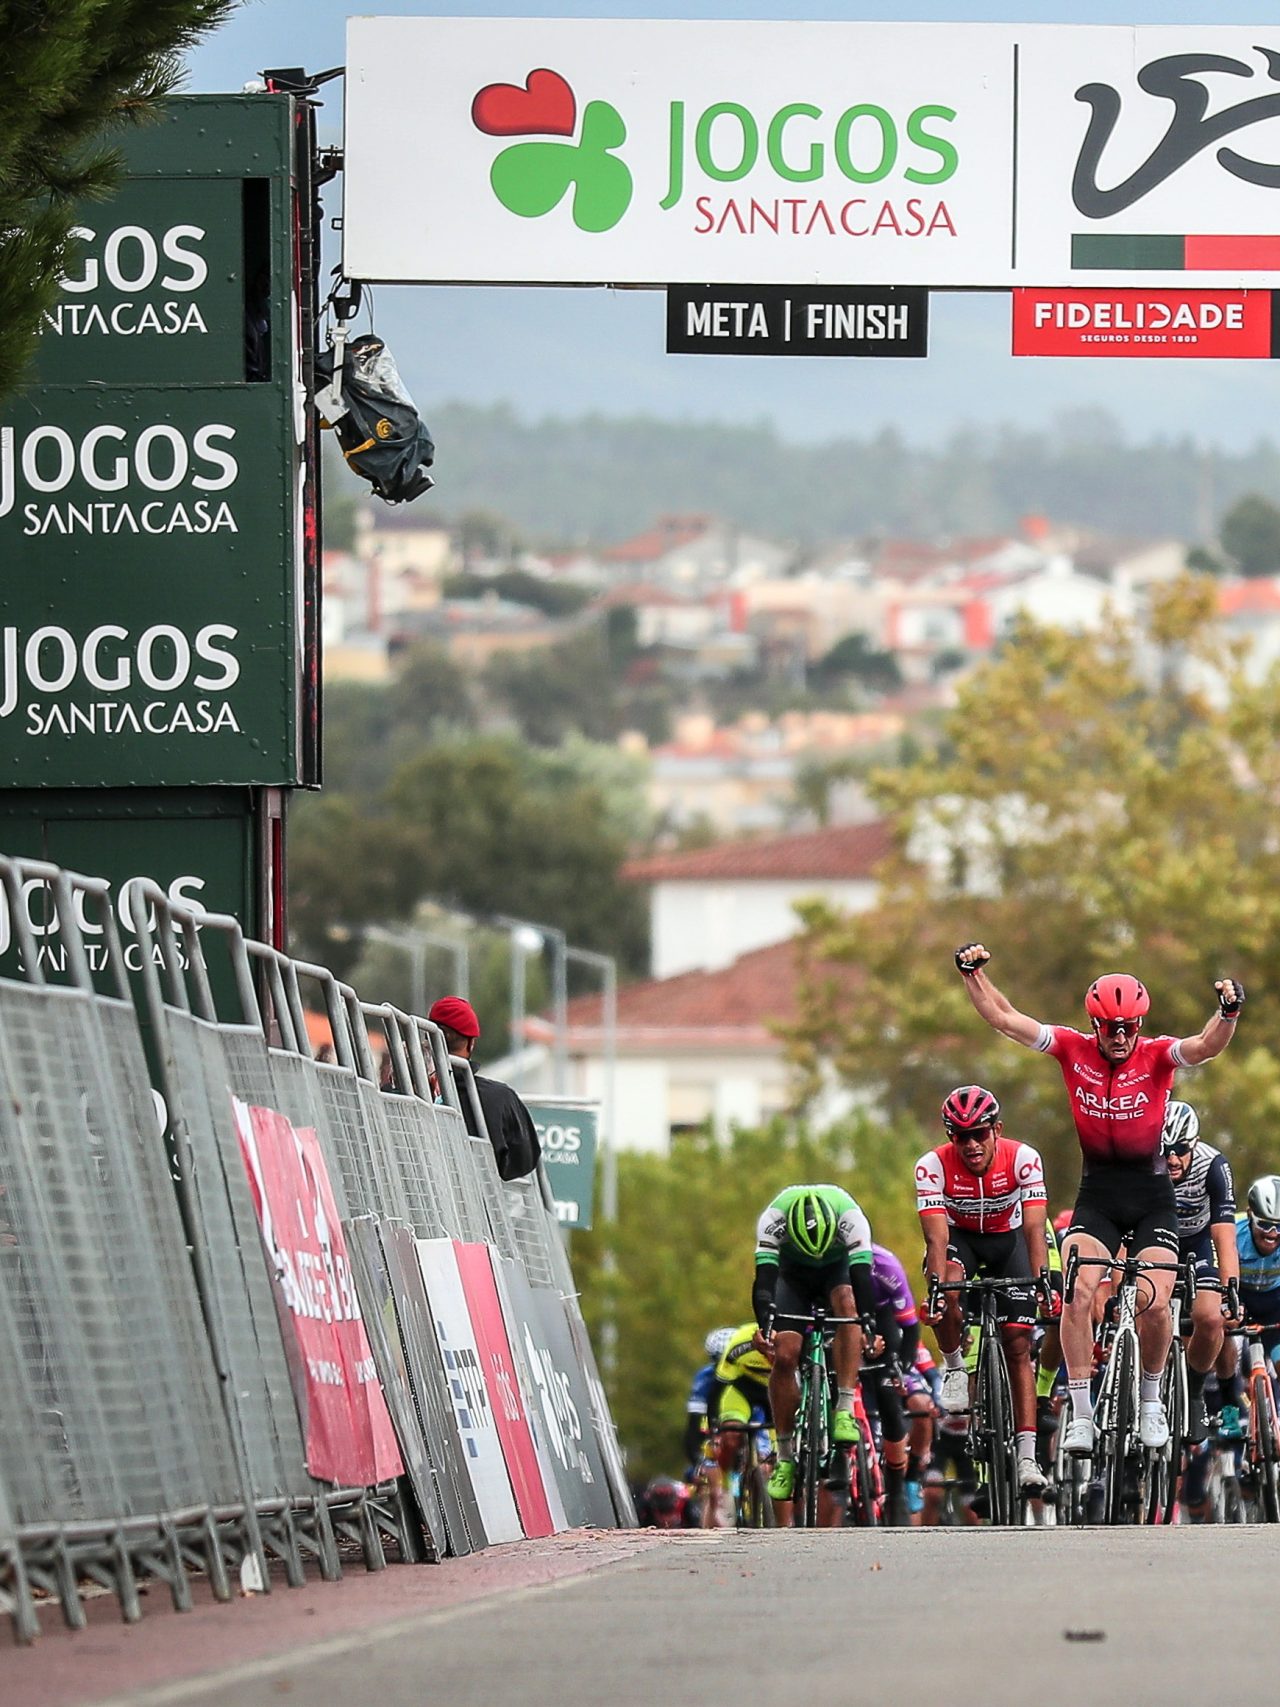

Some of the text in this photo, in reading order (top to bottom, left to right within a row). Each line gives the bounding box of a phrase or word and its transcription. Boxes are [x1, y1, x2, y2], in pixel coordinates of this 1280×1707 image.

[659, 101, 959, 211] JOGOS
[694, 197, 958, 237] SANTACASA
[53, 224, 209, 294] GOS
[33, 301, 209, 336] NTACASA
[686, 302, 909, 340] META FINISH
[1035, 303, 1245, 329] FIDELIDADE
[1080, 334, 1198, 343] SEGUROS DESDE 1808
[0, 424, 239, 517] JOGOS
[23, 501, 239, 535] SANTACASA
[0, 623, 241, 717] JOGOS
[26, 700, 241, 735] SANTACASA
[1075, 1086, 1149, 1111] ARKEA
